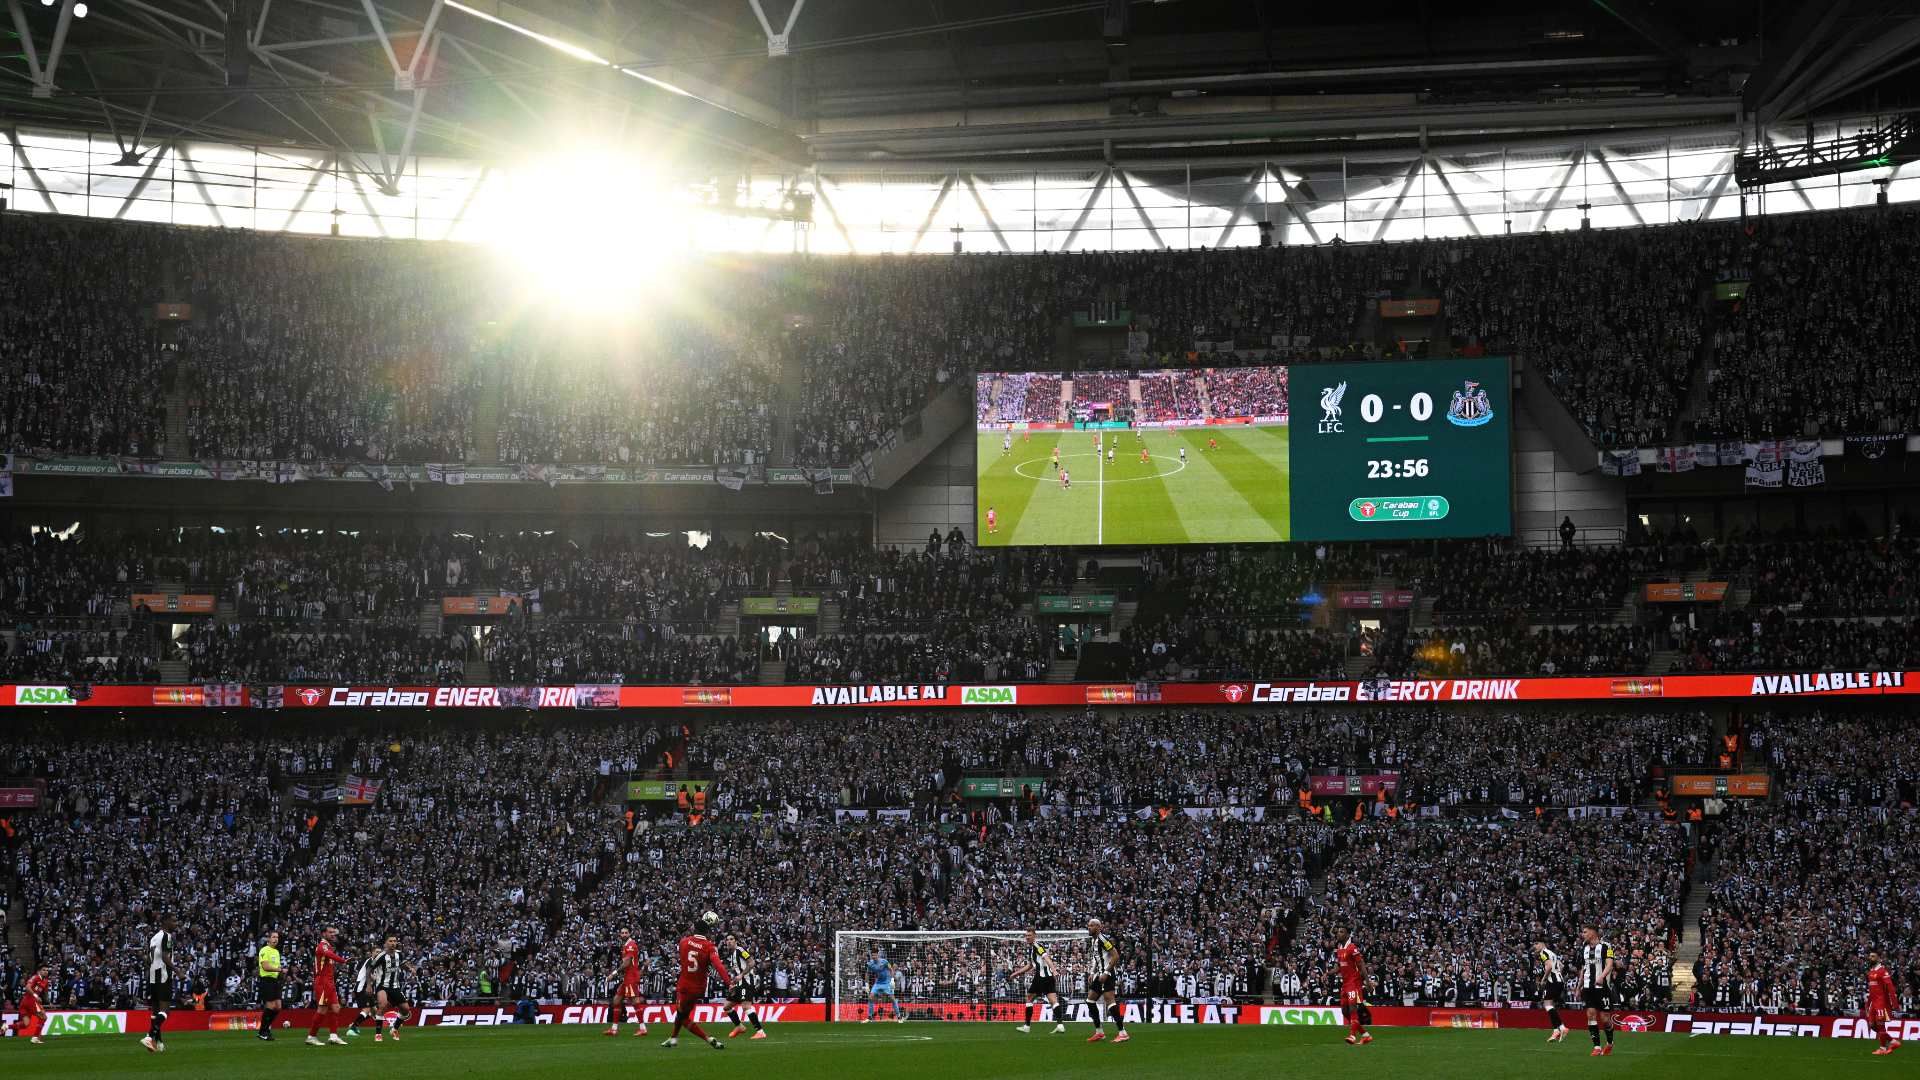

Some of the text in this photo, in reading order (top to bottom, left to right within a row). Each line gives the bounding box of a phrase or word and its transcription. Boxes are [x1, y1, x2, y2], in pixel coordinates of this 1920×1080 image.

[1361, 394, 1384, 423] 0
[1410, 392, 1433, 421] 0
[1318, 423, 1345, 434] L.F.C.
[35, 463, 77, 472] Carabao
[158, 468, 194, 476] arabao
[1367, 459, 1429, 478] 23:56
[1791, 475, 1824, 486] FAITH
[1383, 501, 1419, 509] Carabao
[1393, 509, 1410, 518] Cup
[1252, 684, 1351, 702] Carabao
[1450, 679, 1520, 700] DRINK
[1752, 674, 1870, 694] AVAILABLE
[20, 688, 72, 703] ASDA
[329, 688, 429, 706] Carabao
[812, 685, 919, 705] AVAILABLE
[965, 688, 1014, 703] ASDA
[688, 950, 698, 973] 5
[1203, 1004, 1237, 1024] AT
[1266, 1009, 1337, 1024] ASDA
[47, 1014, 120, 1033] ASDA
